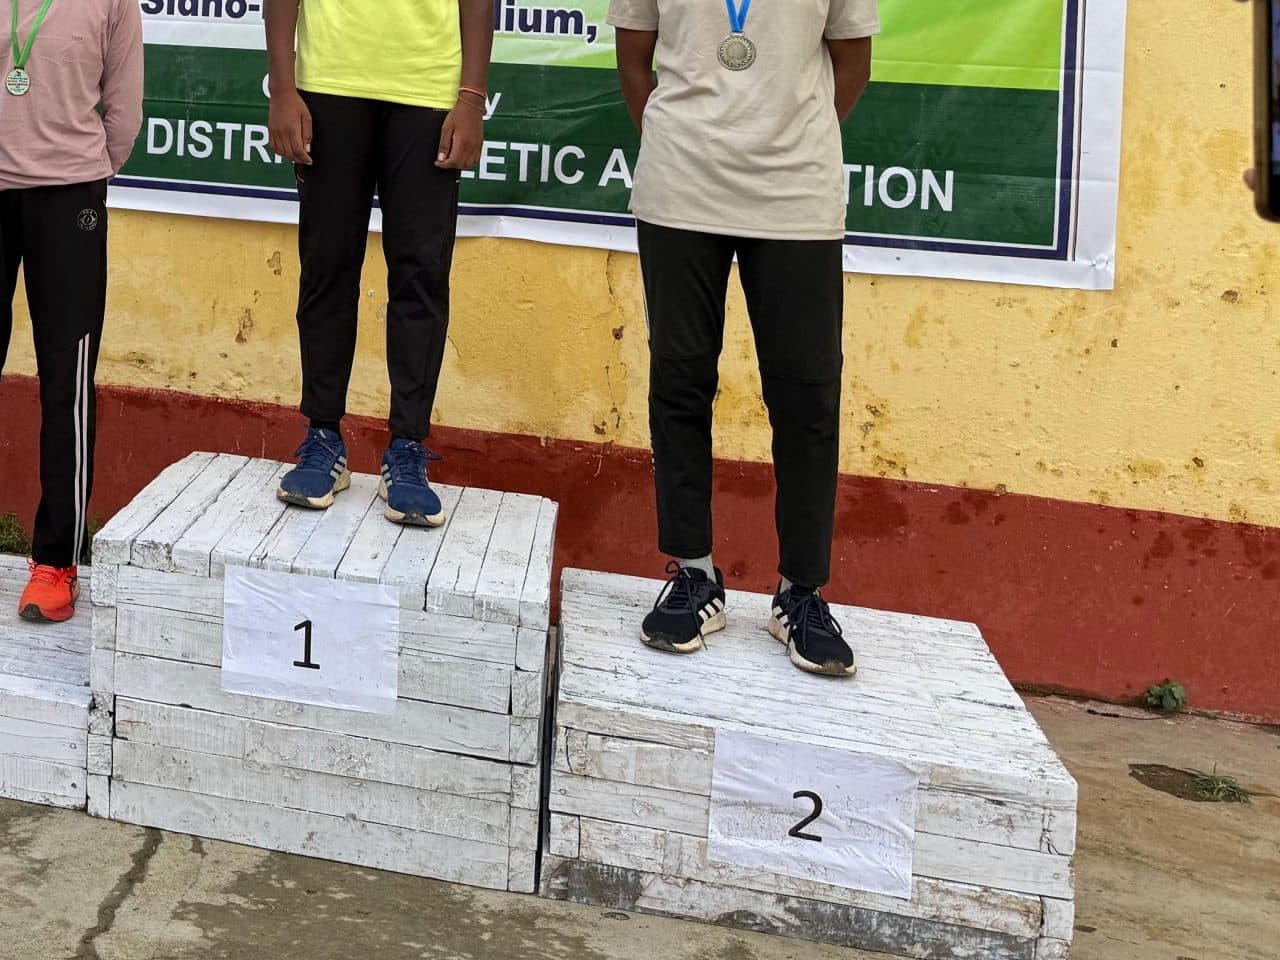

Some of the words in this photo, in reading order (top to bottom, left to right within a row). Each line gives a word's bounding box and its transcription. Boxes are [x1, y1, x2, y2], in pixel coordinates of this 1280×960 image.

[146, 117, 296, 164] DISTR
[292, 619, 322, 671] 1
[787, 789, 824, 843] 2
